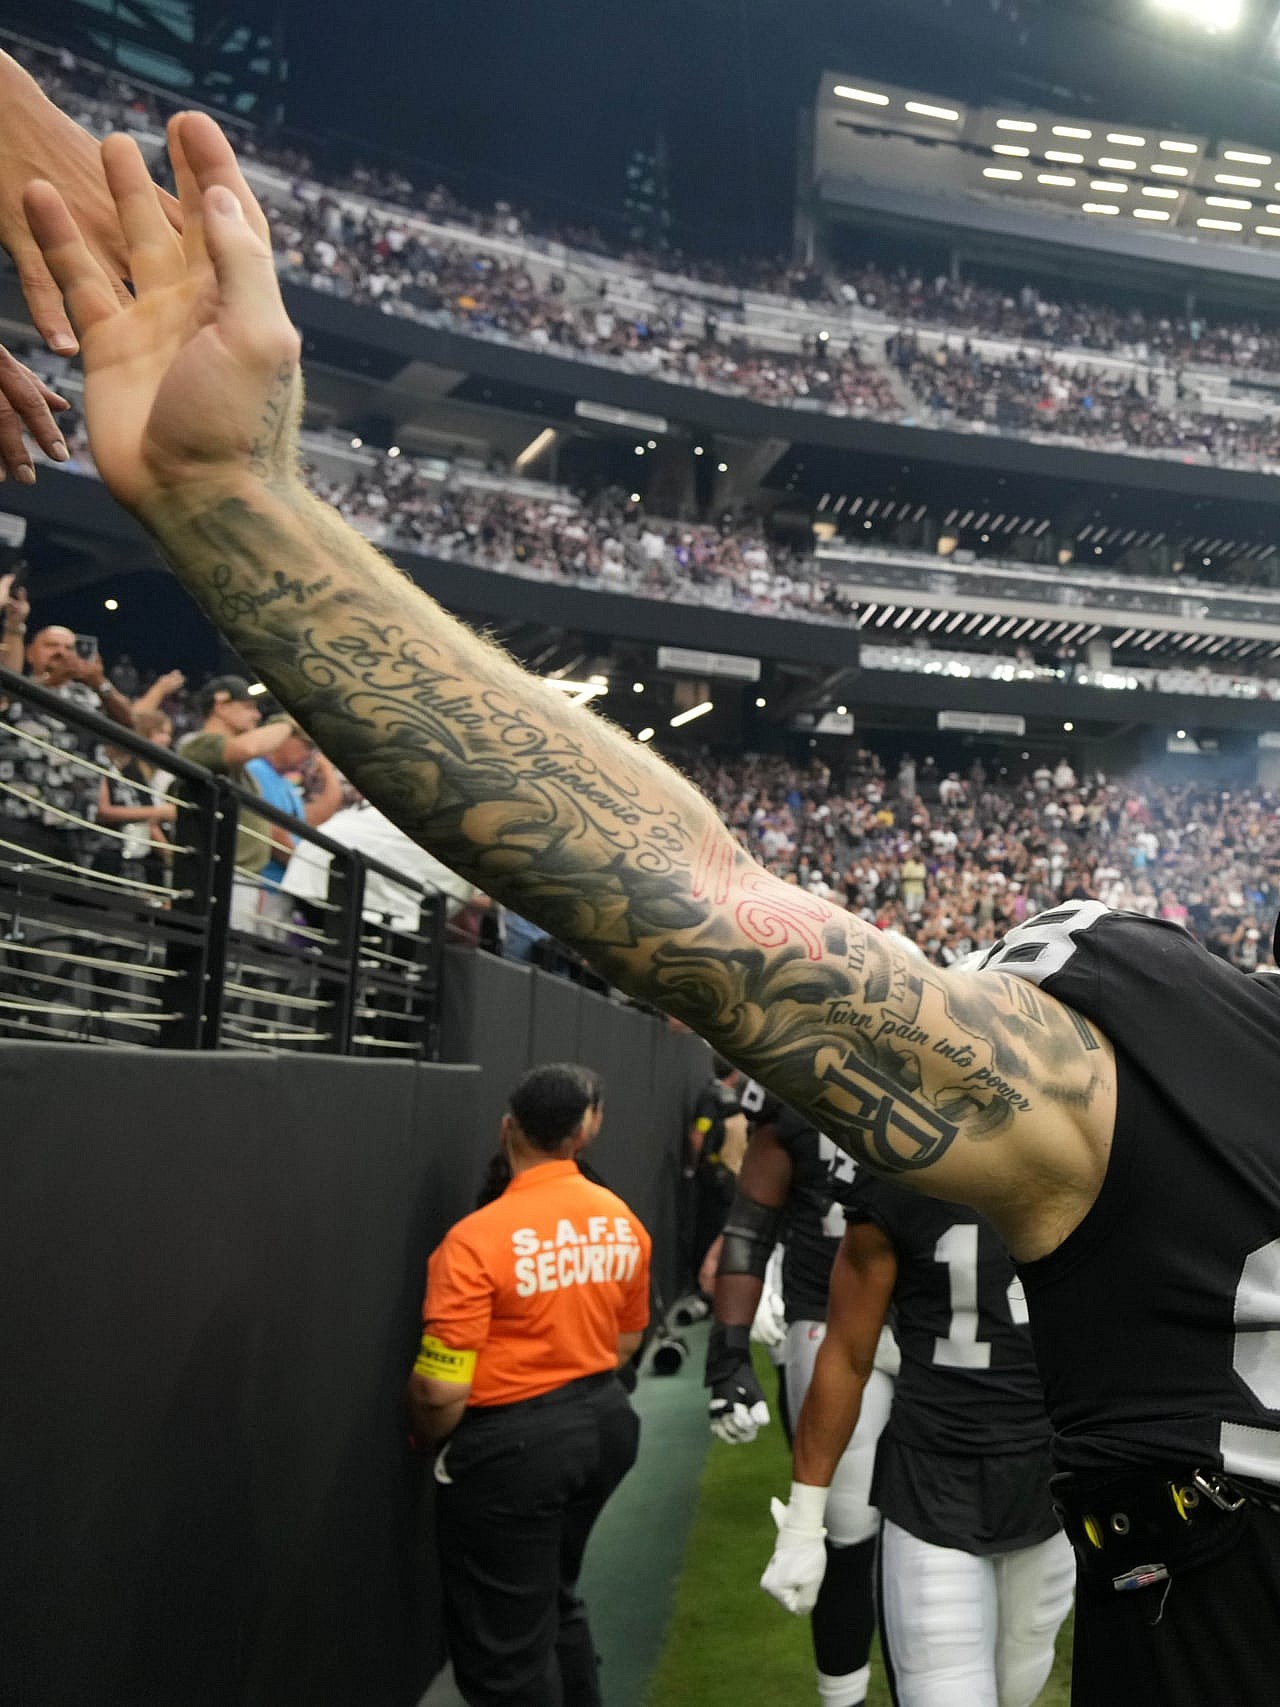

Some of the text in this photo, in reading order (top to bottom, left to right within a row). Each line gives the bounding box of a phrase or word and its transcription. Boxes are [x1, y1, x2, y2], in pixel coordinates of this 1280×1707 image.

[826, 1001, 1033, 1112] Turn pain into power
[514, 1245, 641, 1298] SECURITY
